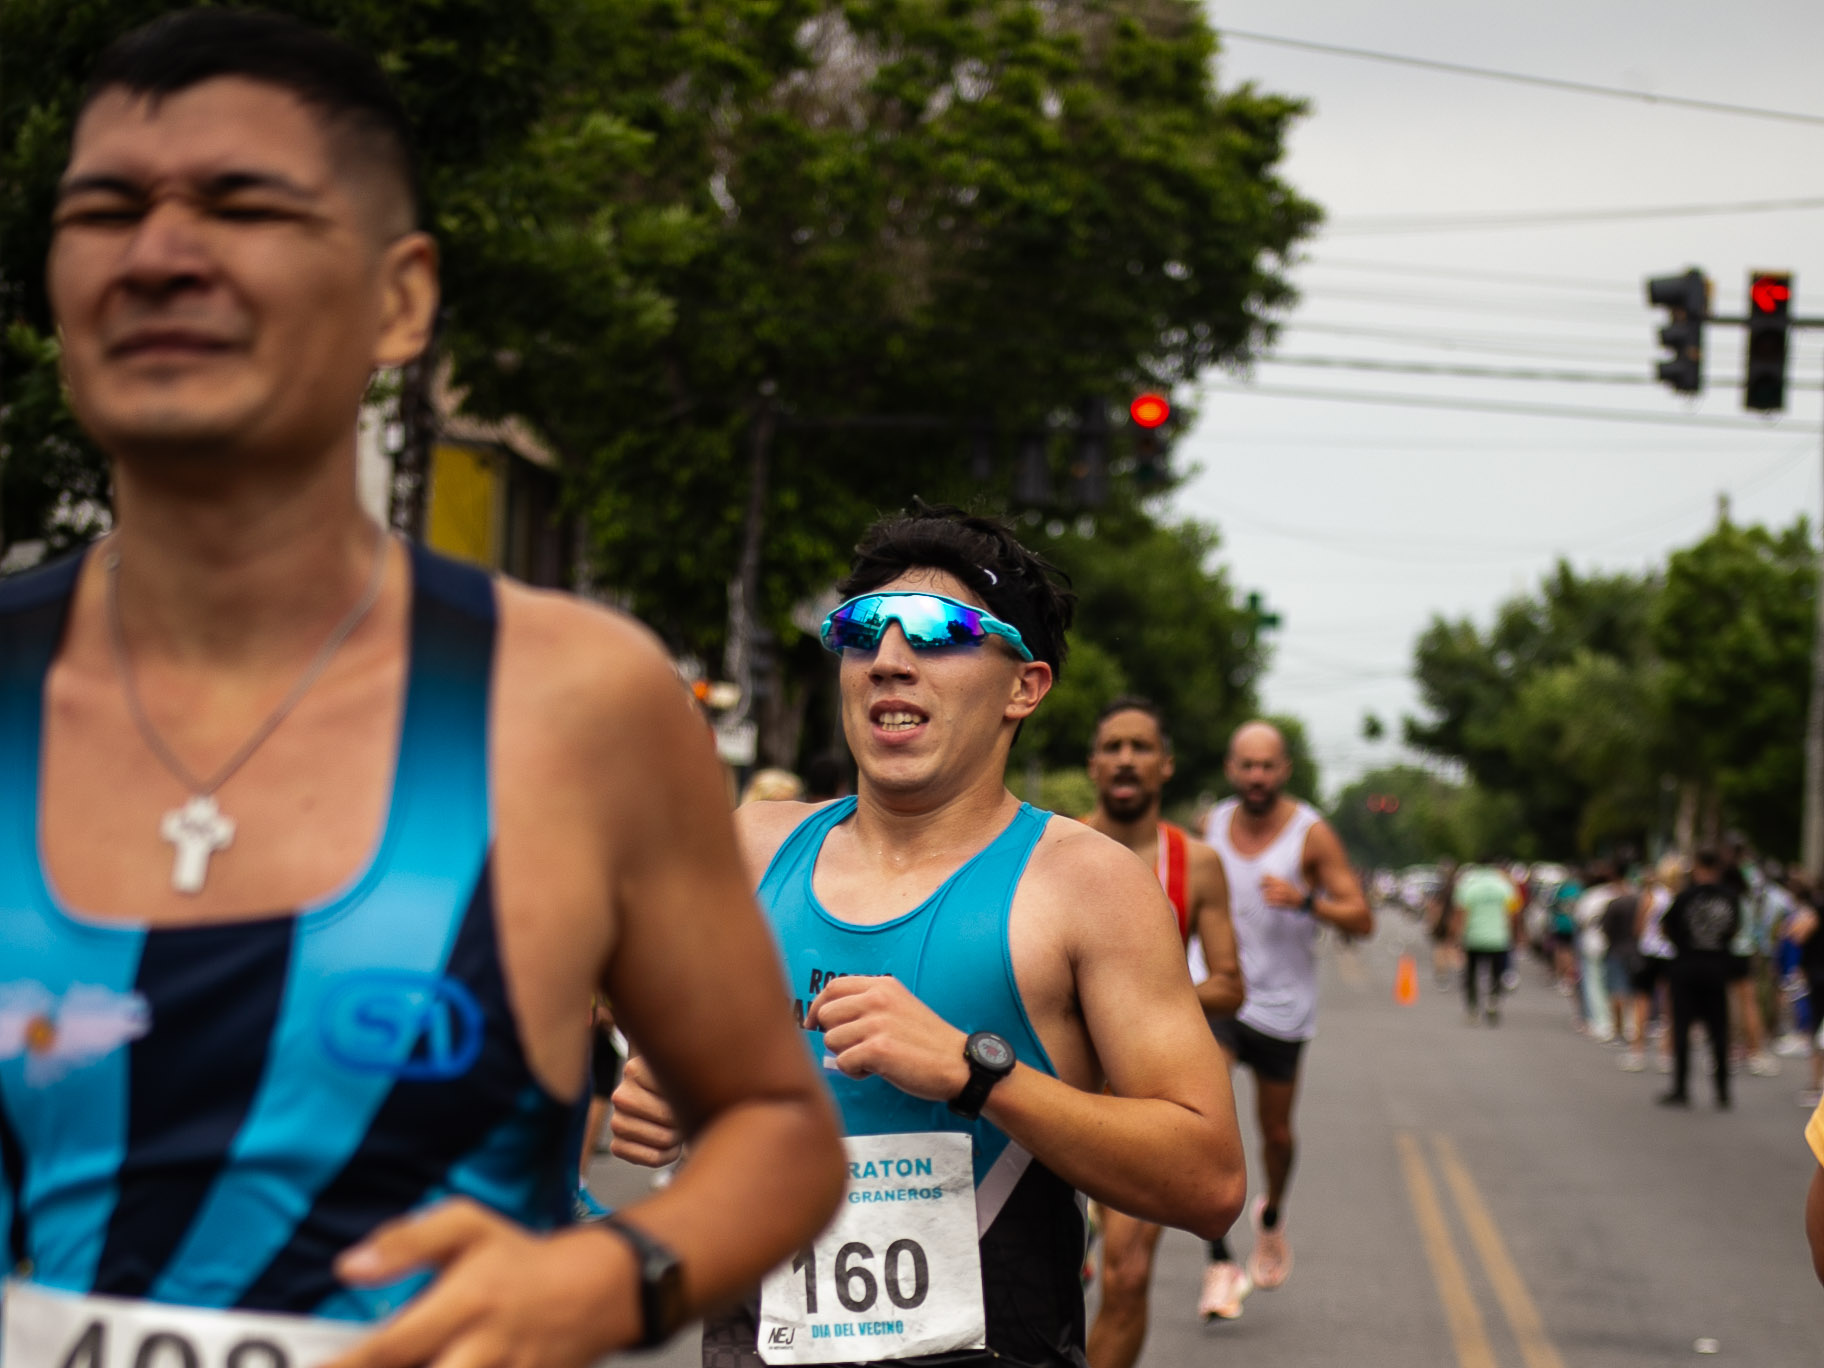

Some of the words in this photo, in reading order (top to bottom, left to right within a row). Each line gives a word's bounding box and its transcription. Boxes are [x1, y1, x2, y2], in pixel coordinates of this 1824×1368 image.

[848, 1187, 943, 1204] GRANEROS
[792, 1238, 929, 1314] 160
[811, 1324, 831, 1339] DIA
[834, 1322, 855, 1337] DEL
[858, 1319, 904, 1336] VECINO
